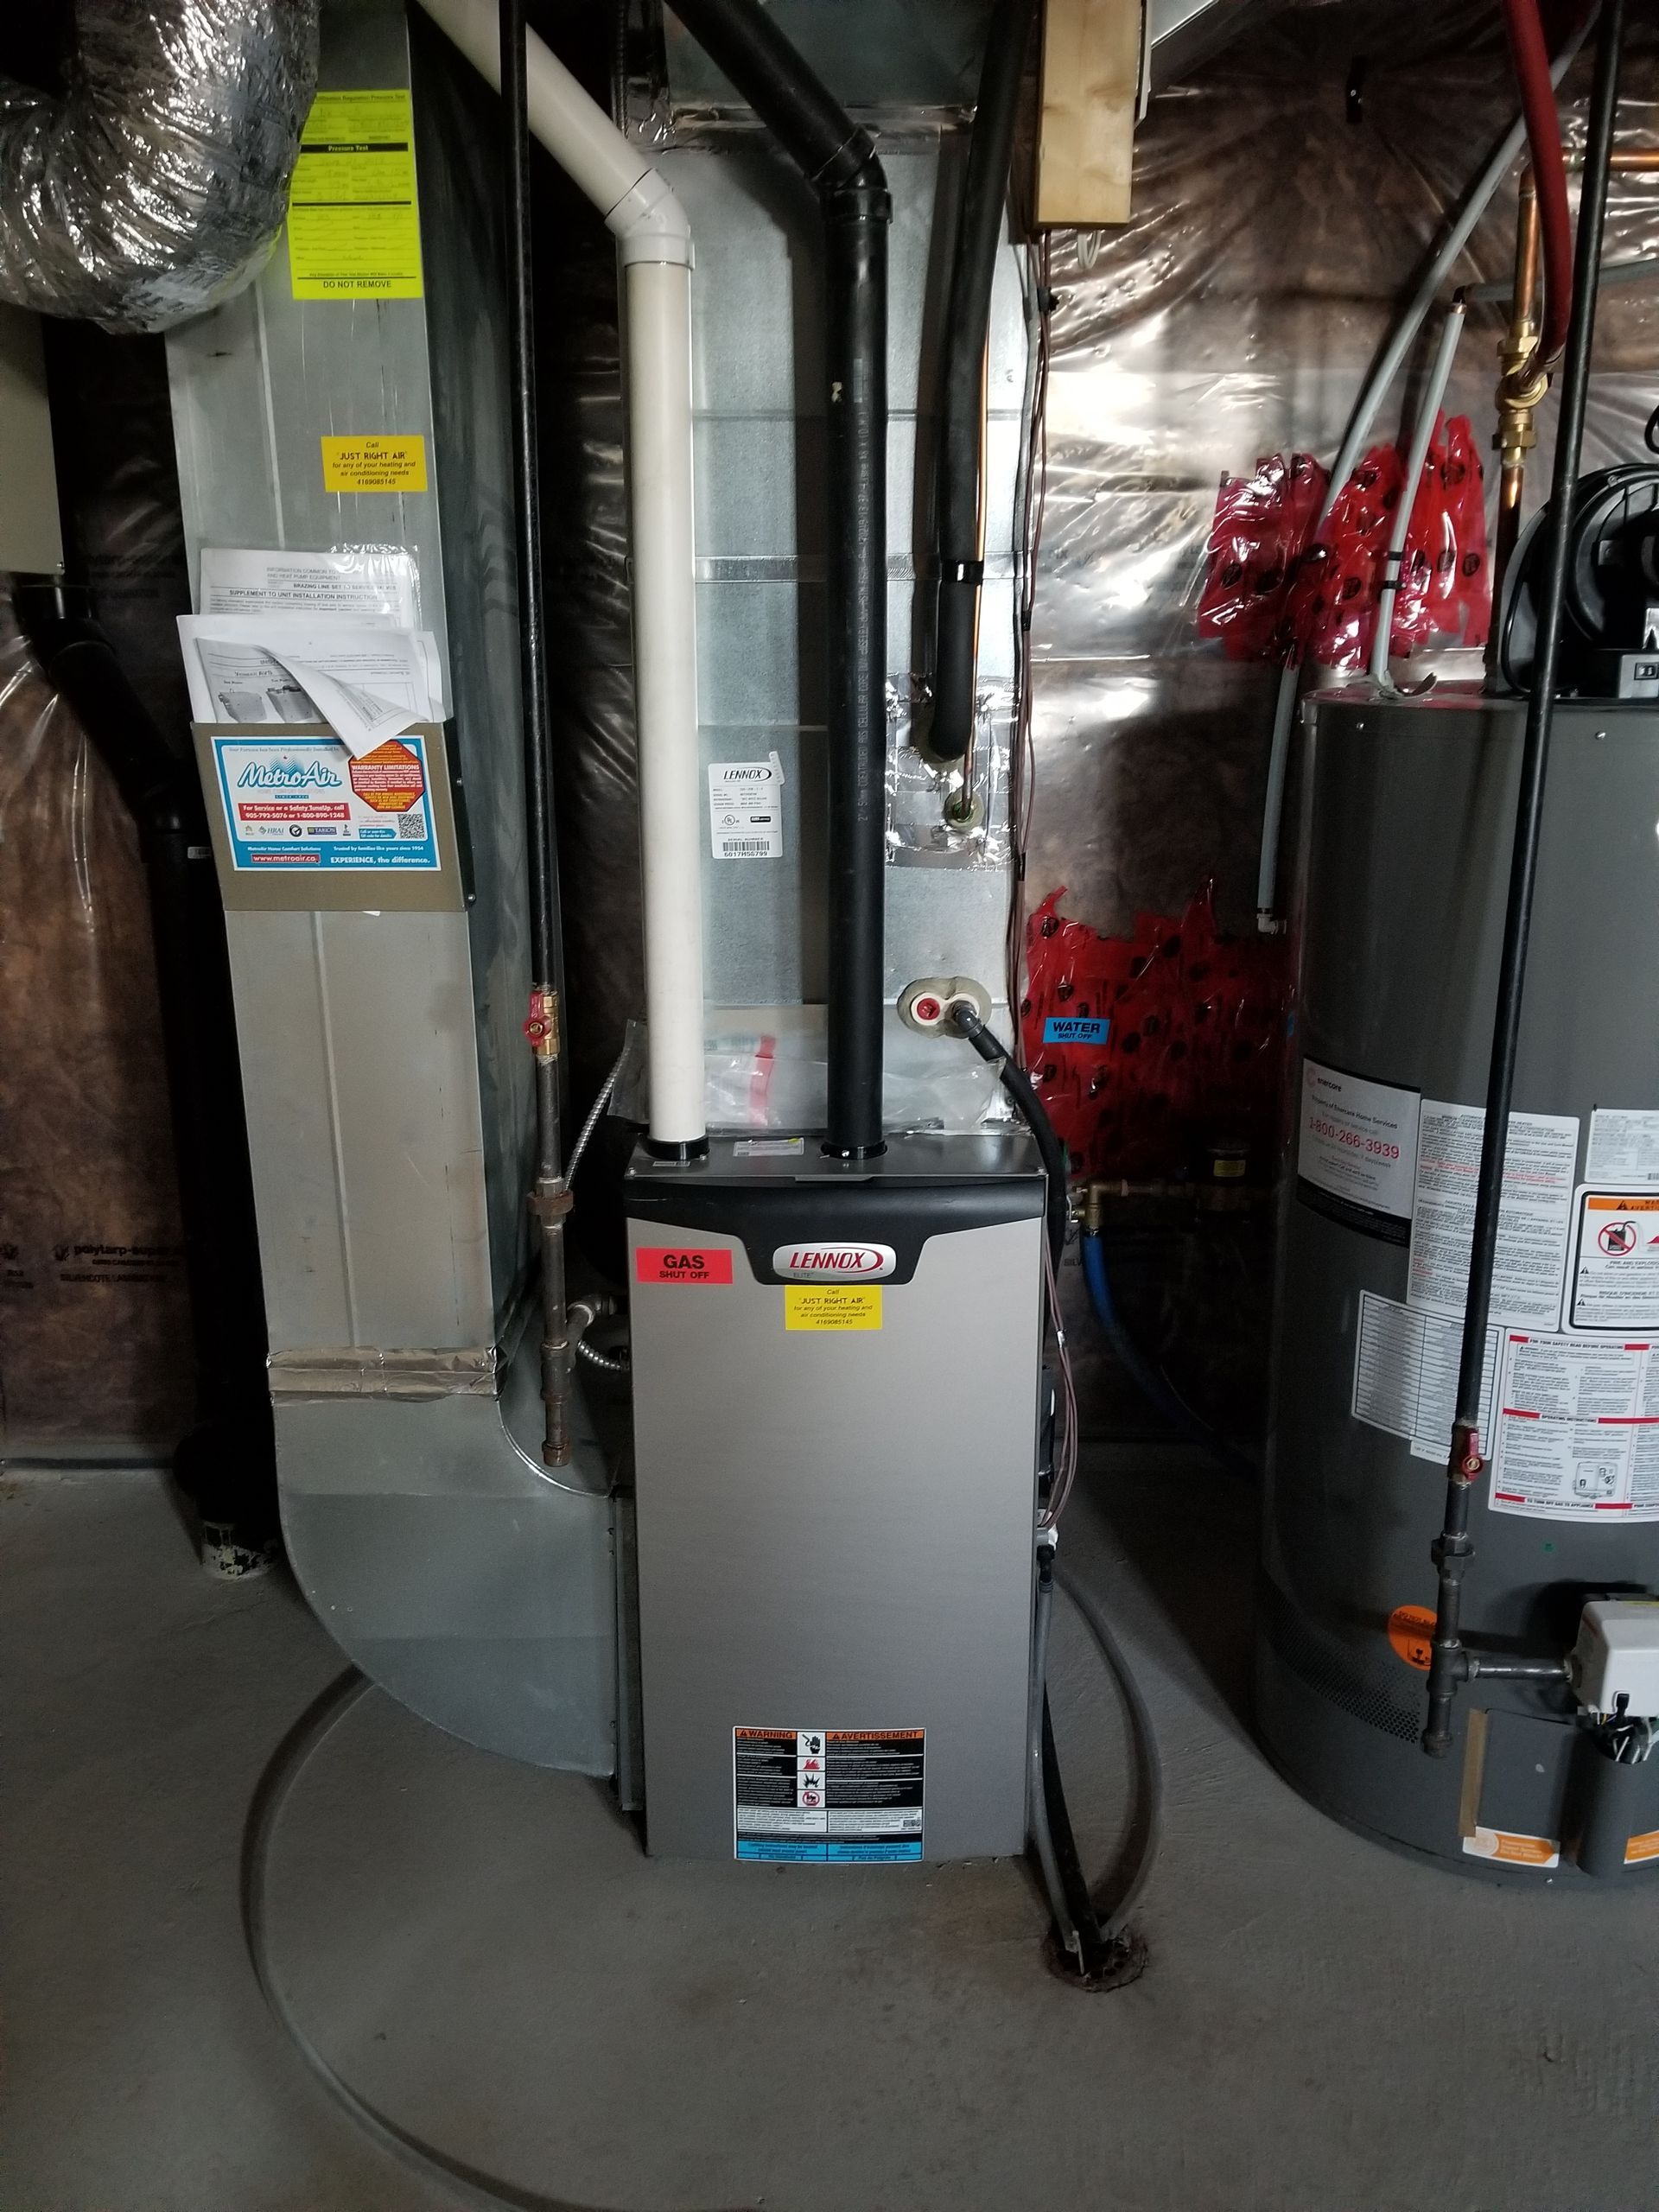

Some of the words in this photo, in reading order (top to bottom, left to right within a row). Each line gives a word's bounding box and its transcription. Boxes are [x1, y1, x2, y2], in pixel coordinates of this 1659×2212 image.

[857, 673, 869, 692] CORE
[857, 695, 869, 728] CELLULAR
[237, 760, 343, 788] MetroAir
[723, 769, 763, 779] LENNOX
[1052, 1022, 1101, 1033] WATER
[1355, 1112, 1371, 1122] Home
[1372, 1116, 1398, 1129] Services
[1309, 1116, 1400, 1159] 1-800-266-3939
[663, 1255, 705, 1269] GAS
[789, 1252, 865, 1268] LENNOX
[659, 1270, 686, 1279] SHUT
[841, 1731, 918, 1739] AVERTISSEMENT
